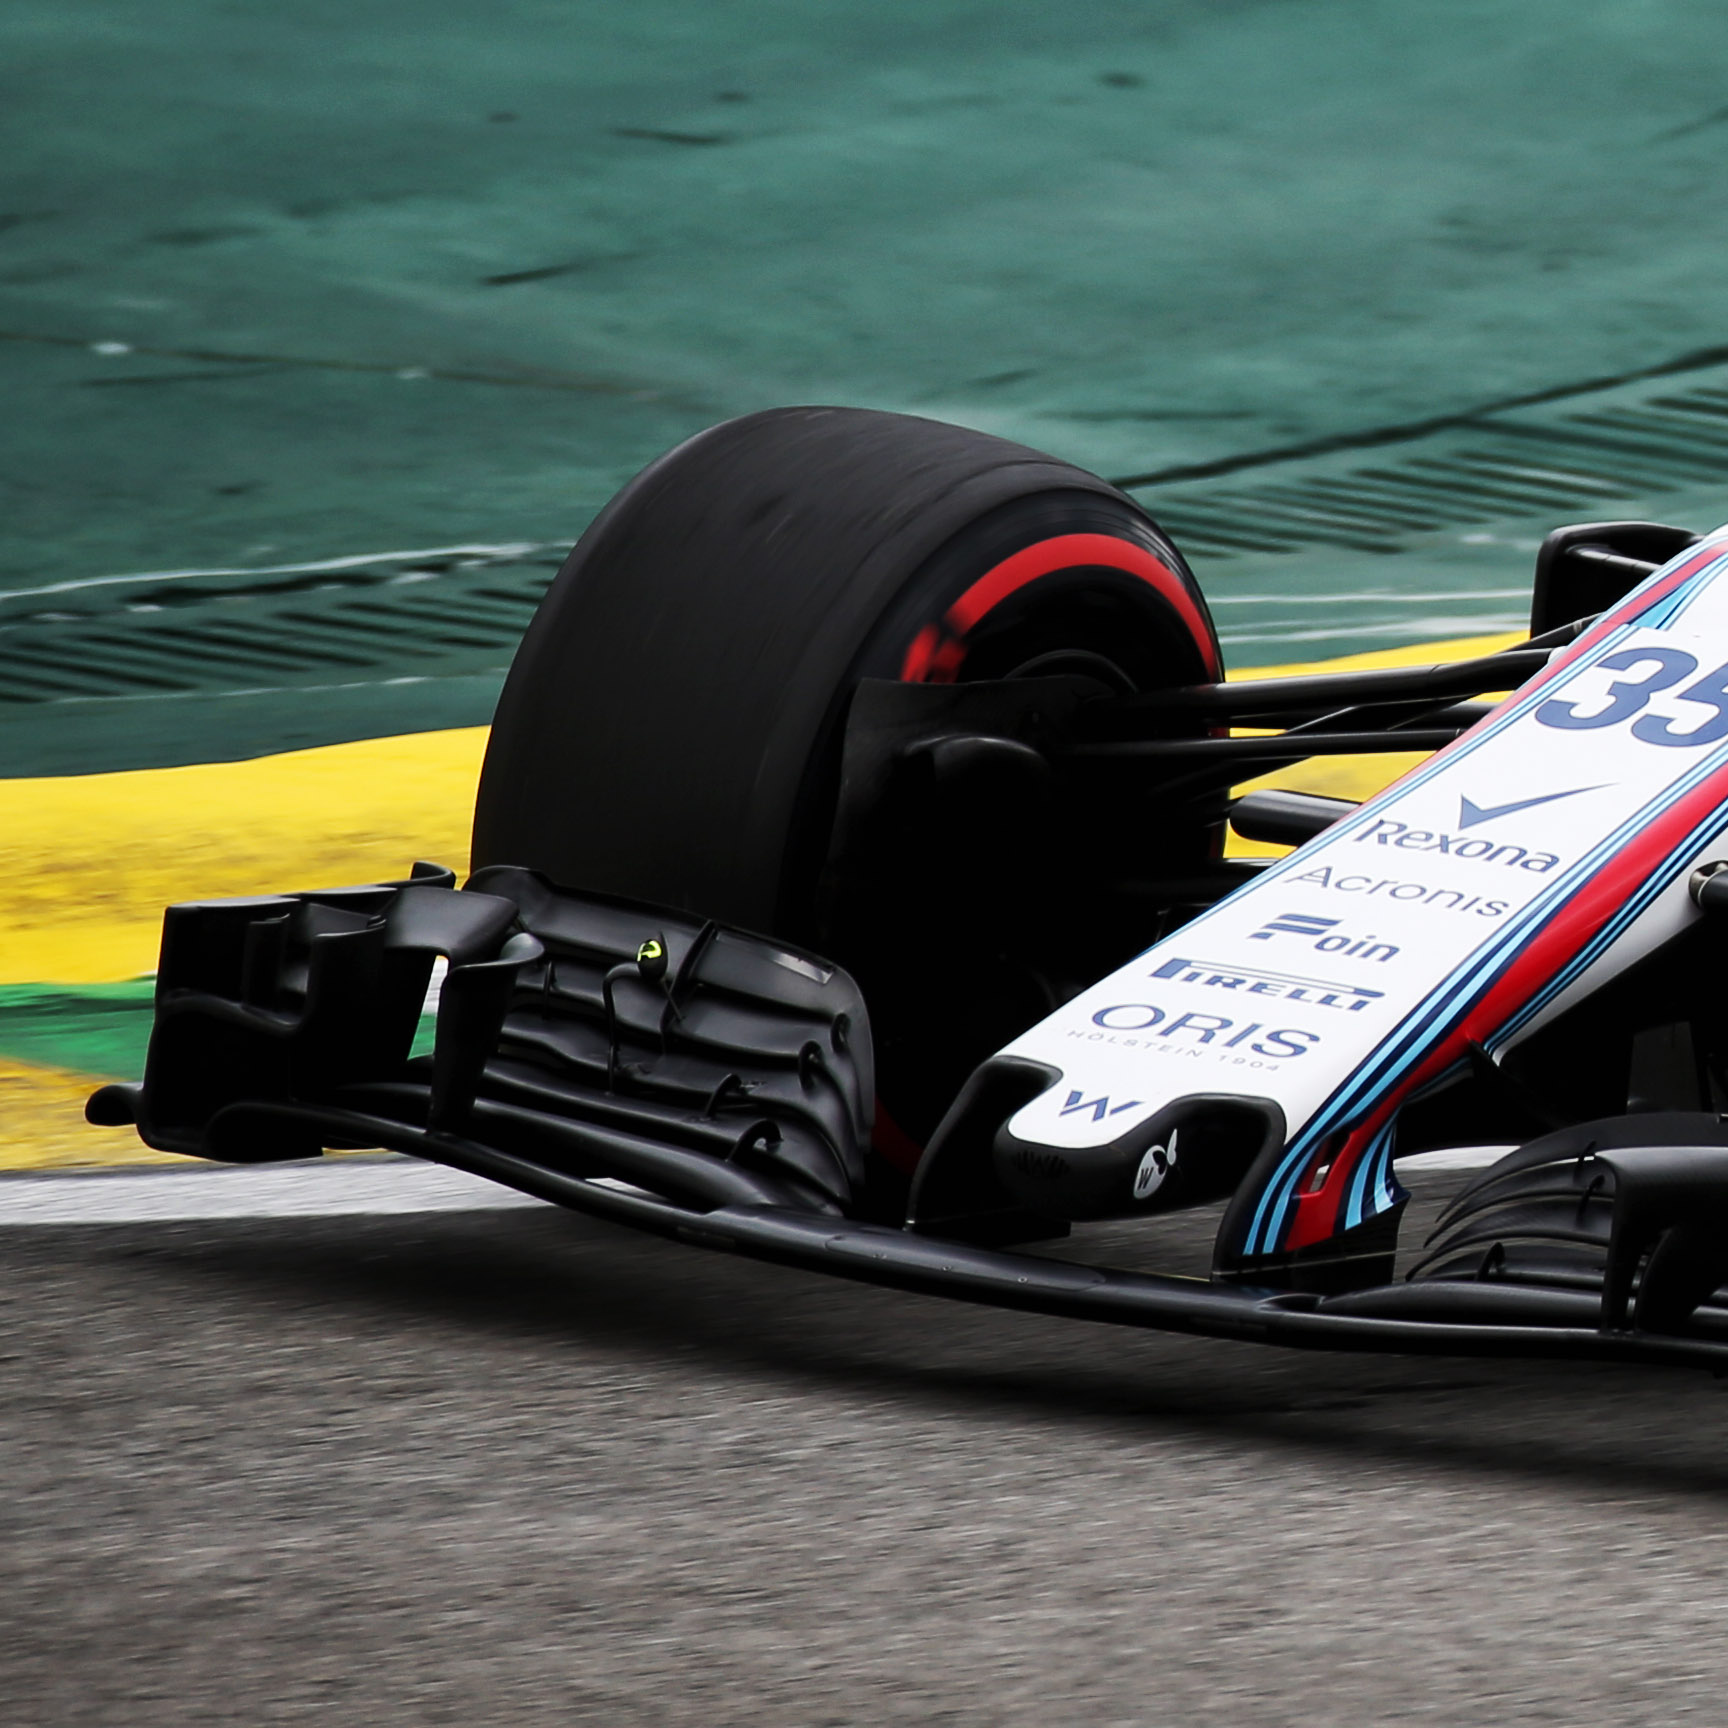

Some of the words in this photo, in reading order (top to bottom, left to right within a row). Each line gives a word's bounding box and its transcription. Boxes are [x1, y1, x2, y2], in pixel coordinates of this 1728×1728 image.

[1354, 818, 1561, 874] Rexona
[1284, 865, 1510, 917] Acronis
[1149, 957, 1386, 1012] PIRELLI
[1092, 1004, 1321, 1058] ORIS
[1217, 1054, 1281, 1073] 1904
